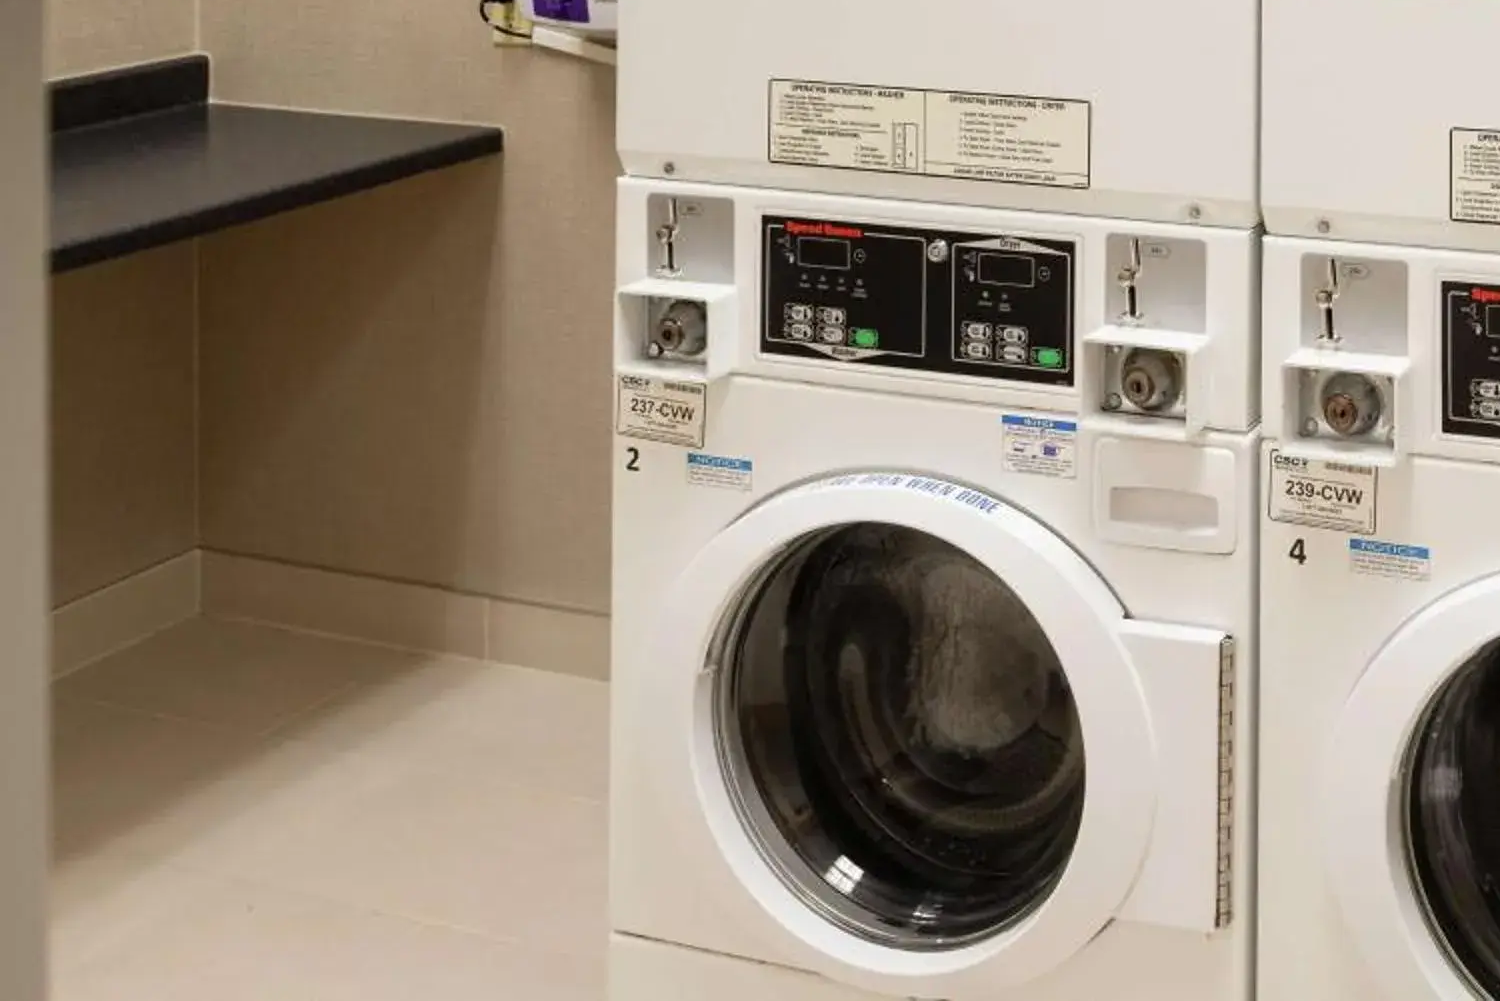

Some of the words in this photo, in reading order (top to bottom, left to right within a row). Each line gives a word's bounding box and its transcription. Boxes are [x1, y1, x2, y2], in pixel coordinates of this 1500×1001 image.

[631, 398, 695, 422] 237-CVW
[626, 446, 640, 472] 2
[906, 477, 955, 497] WHEN
[956, 490, 1000, 515] DONE
[1285, 480, 1363, 505] 239-CVW
[1289, 538, 1307, 565] 4
